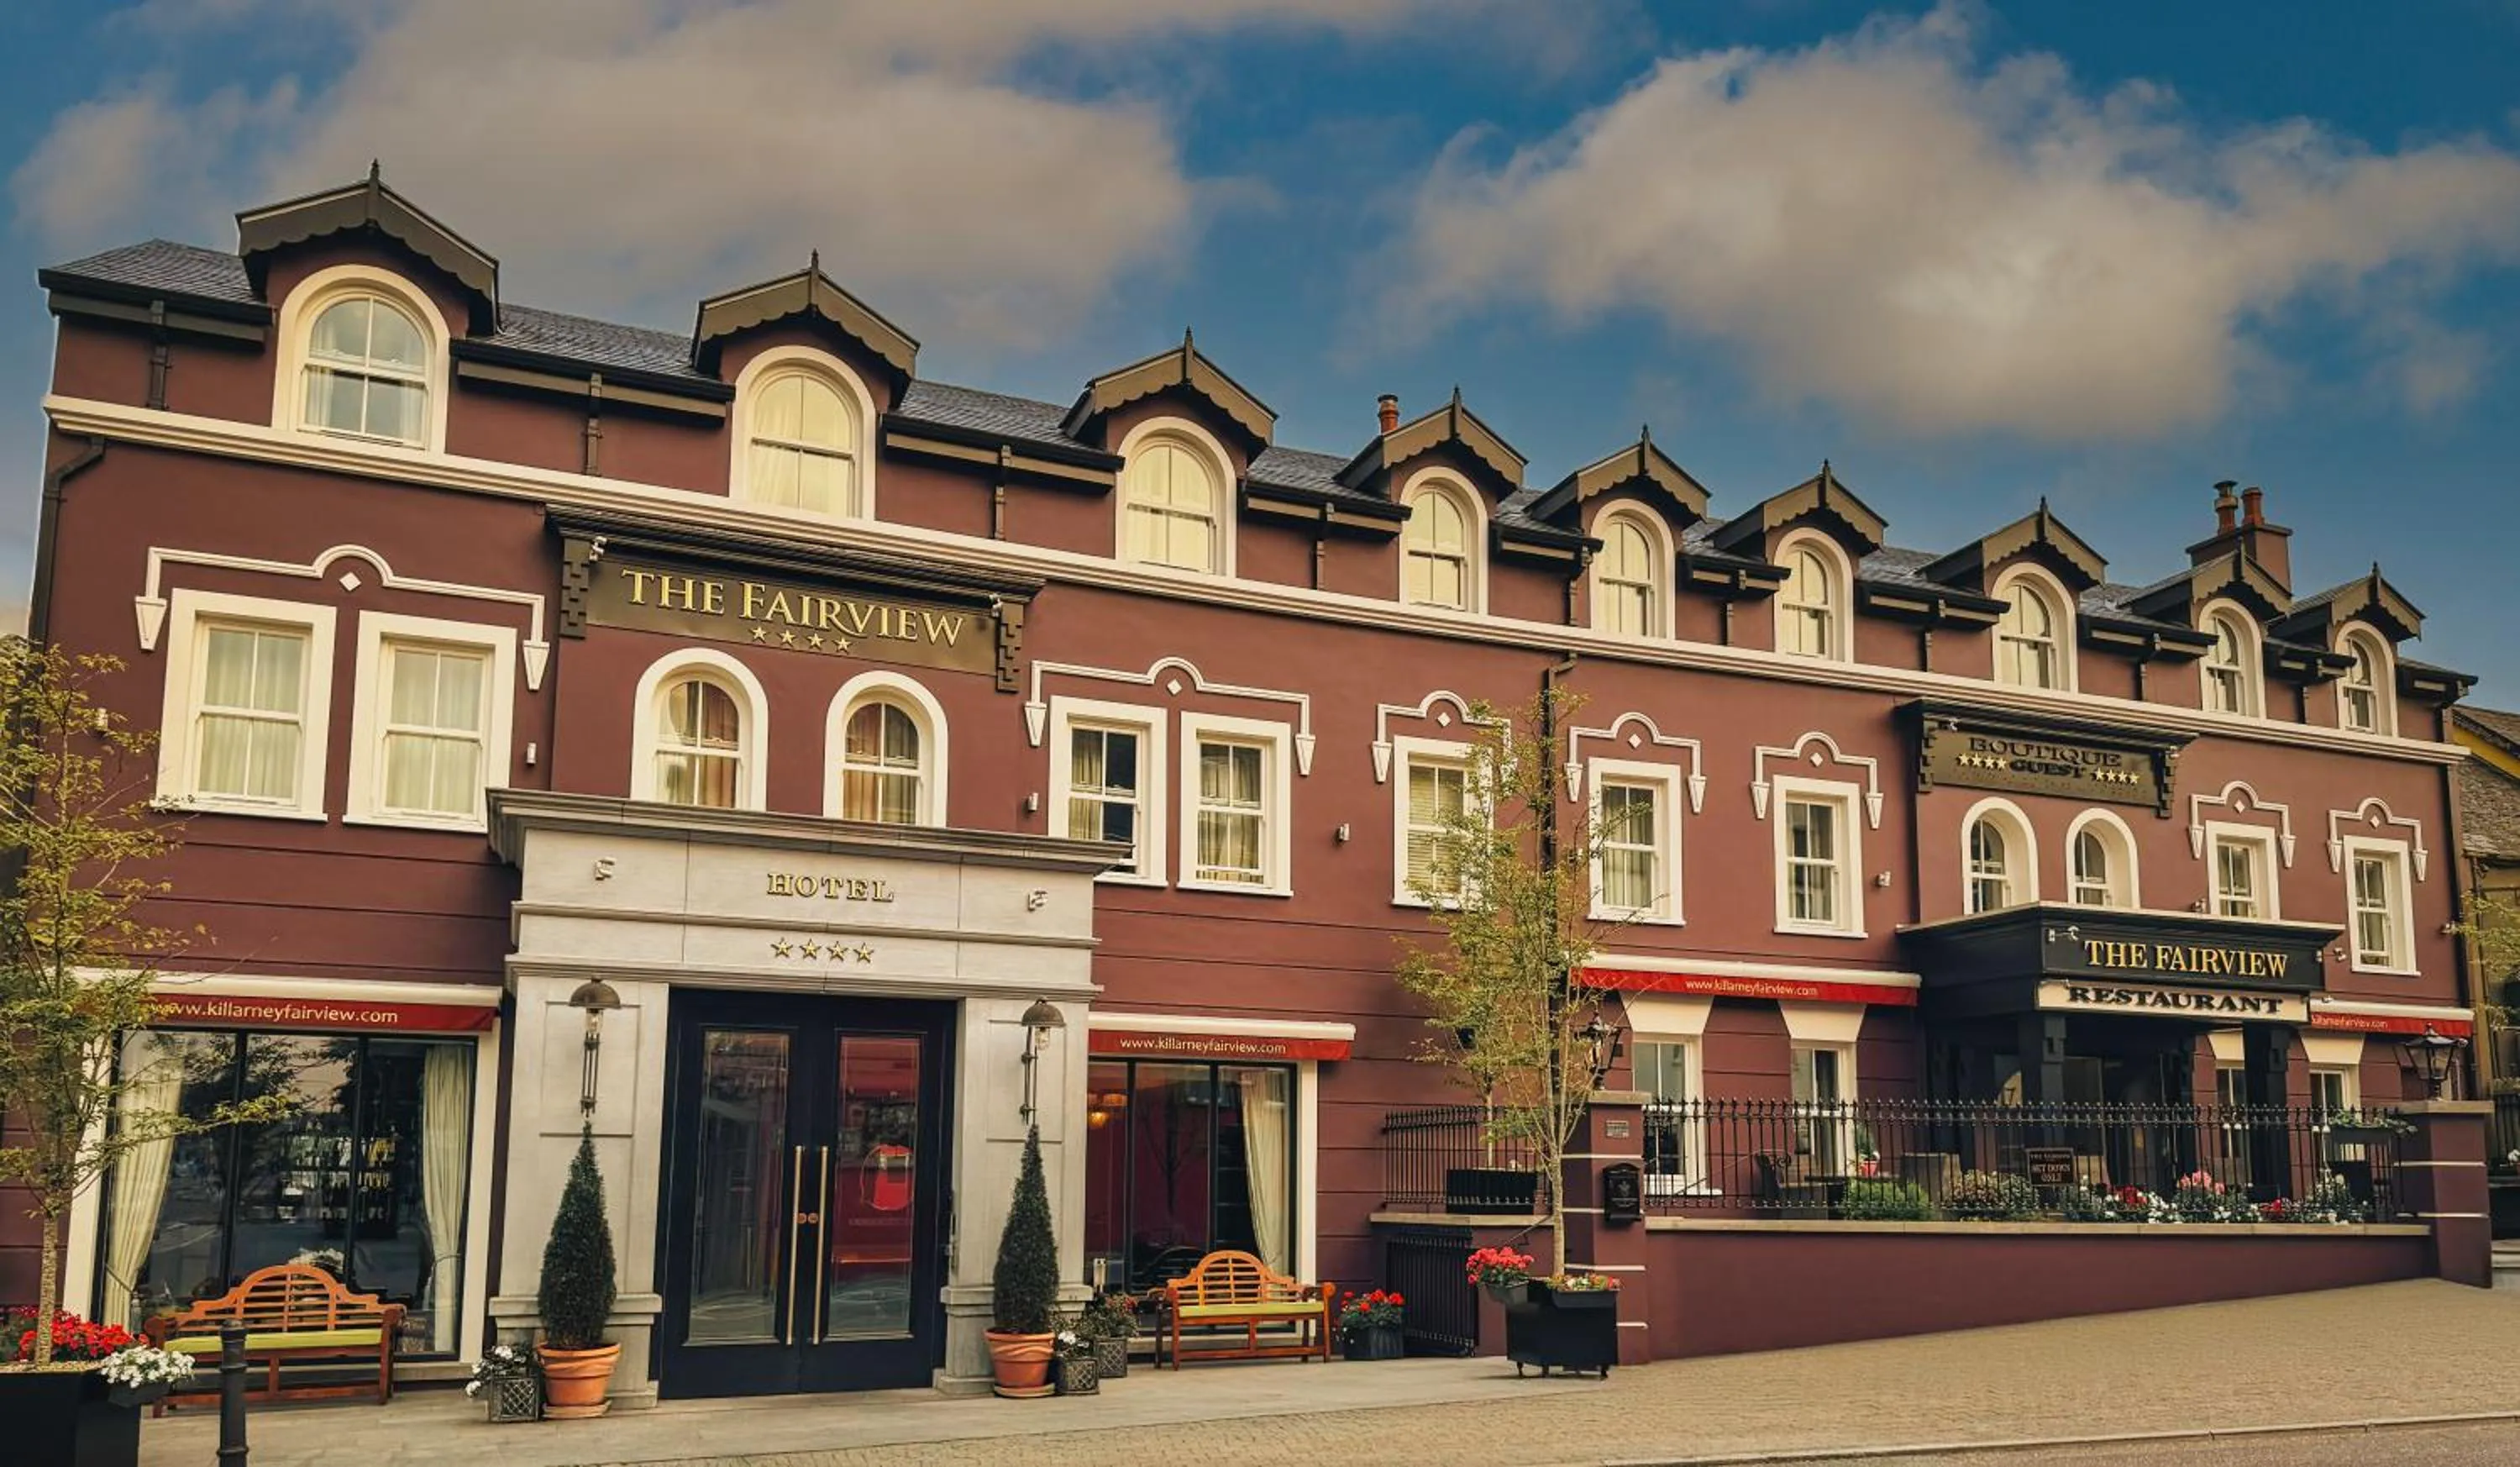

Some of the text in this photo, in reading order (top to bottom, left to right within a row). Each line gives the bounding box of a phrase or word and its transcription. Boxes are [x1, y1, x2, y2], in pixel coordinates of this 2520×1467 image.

[620, 568, 964, 647] THE FAIRVIEW
[1968, 736, 2123, 768] BOUTIQUE
[2008, 758, 2088, 780] GUEST
[766, 871, 895, 903] HOTEL
[2083, 939, 2289, 979] THE FAIRVIEW
[1685, 978, 1819, 996] www.killarneyfairview.com
[2067, 986, 2284, 1014] RESTAURANT
[1120, 1037, 1286, 1055] www.killarneyfairview.com
